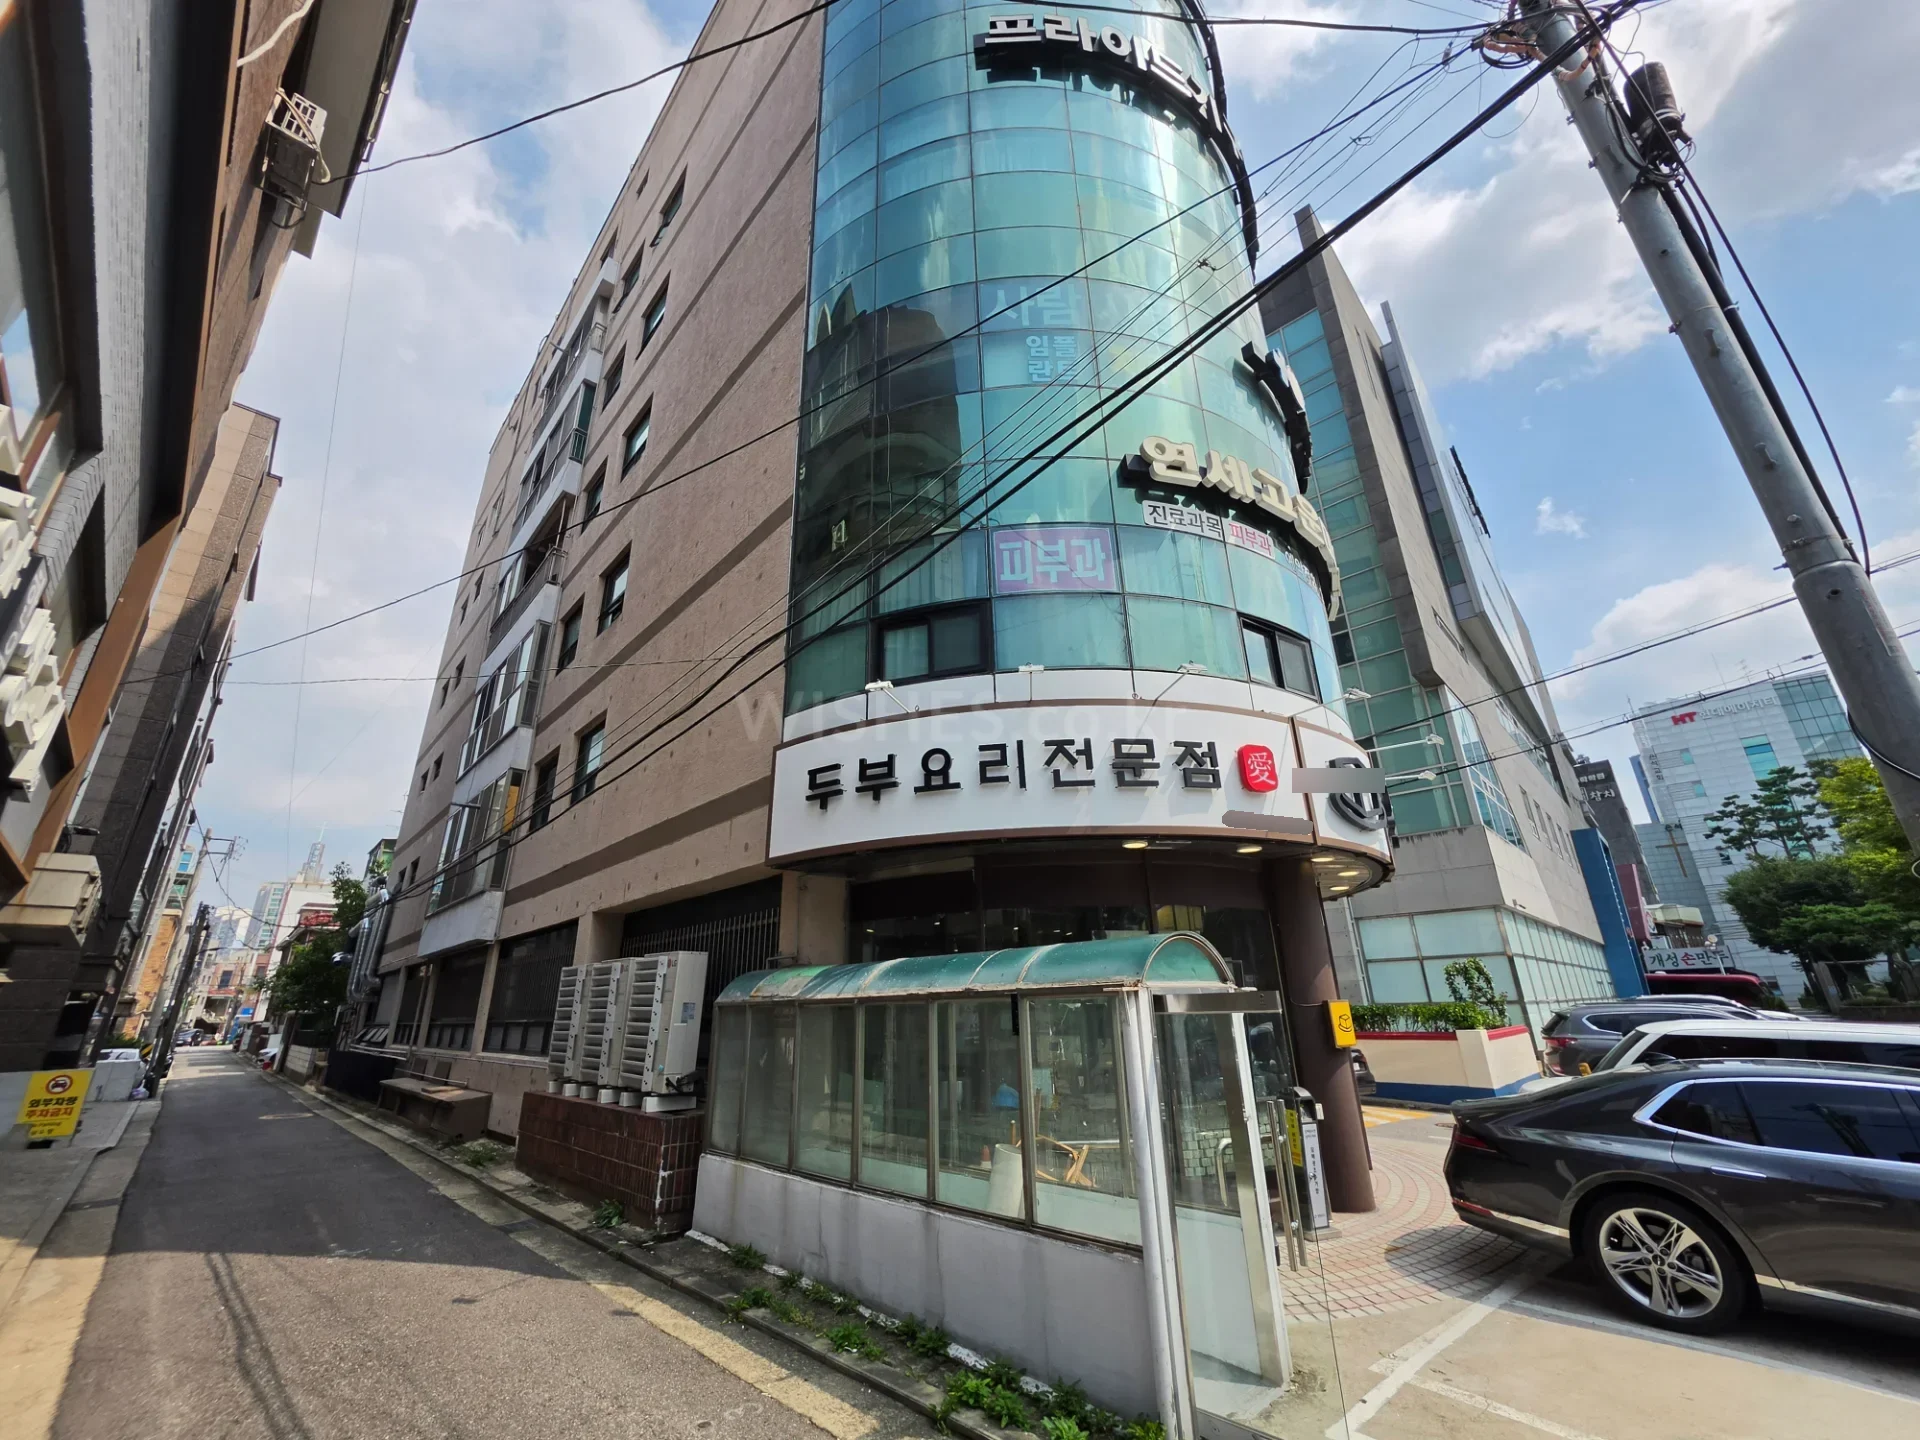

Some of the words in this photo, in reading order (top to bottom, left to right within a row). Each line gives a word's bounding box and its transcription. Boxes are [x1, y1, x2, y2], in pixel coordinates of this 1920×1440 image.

[1148, 504, 1223, 537] 진료과목
[1228, 522, 1272, 557] 피부과
[999, 538, 1106, 584] 피부과
[1671, 711, 1697, 725] HT
[805, 738, 1222, 812] 두부요리전문점
[1247, 751, 1276, 786] 愛
[1649, 949, 1729, 968] 개성손만두
[25, 1107, 74, 1119] 주차금지
[28, 1096, 78, 1108] 외부차량
